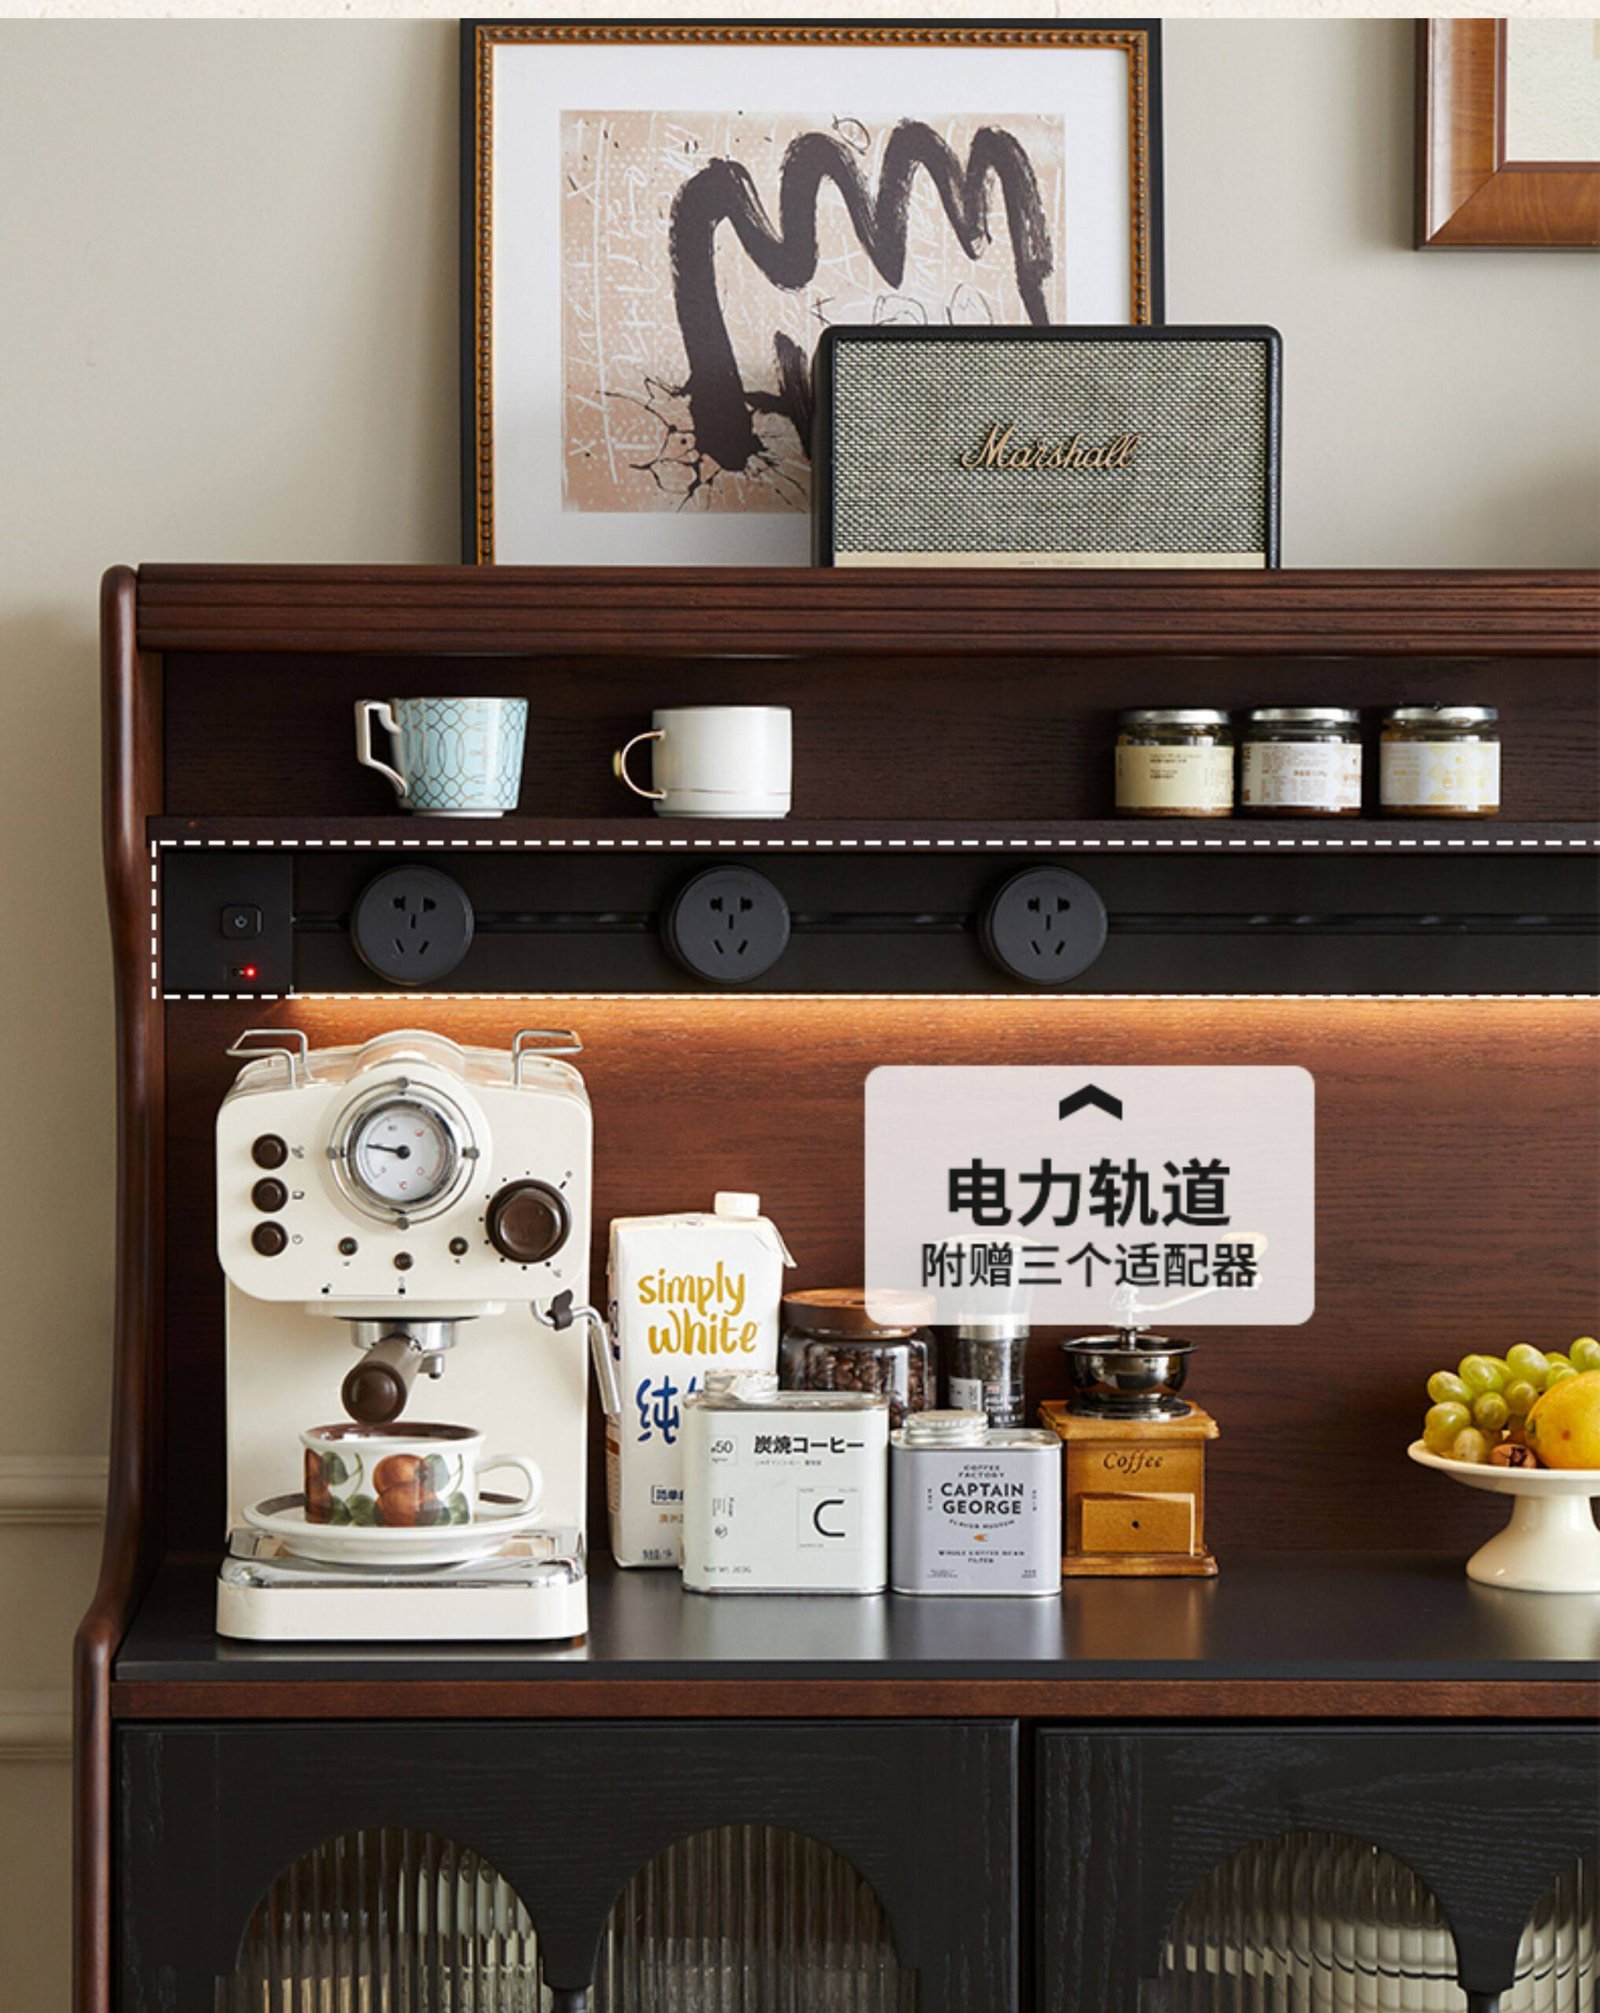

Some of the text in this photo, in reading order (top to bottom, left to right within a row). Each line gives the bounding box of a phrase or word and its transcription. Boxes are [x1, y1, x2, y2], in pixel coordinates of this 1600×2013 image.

[961, 422, 1140, 469] Marshall
[638, 1261, 745, 1317] simply
[648, 1308, 759, 1355] white
[754, 1435, 864, 1455] 炭焼コーヒー
[1103, 1450, 1163, 1474] Coffee
[941, 1482, 1024, 1497] CAPTAIN
[943, 1500, 1022, 1514] GEORGE
